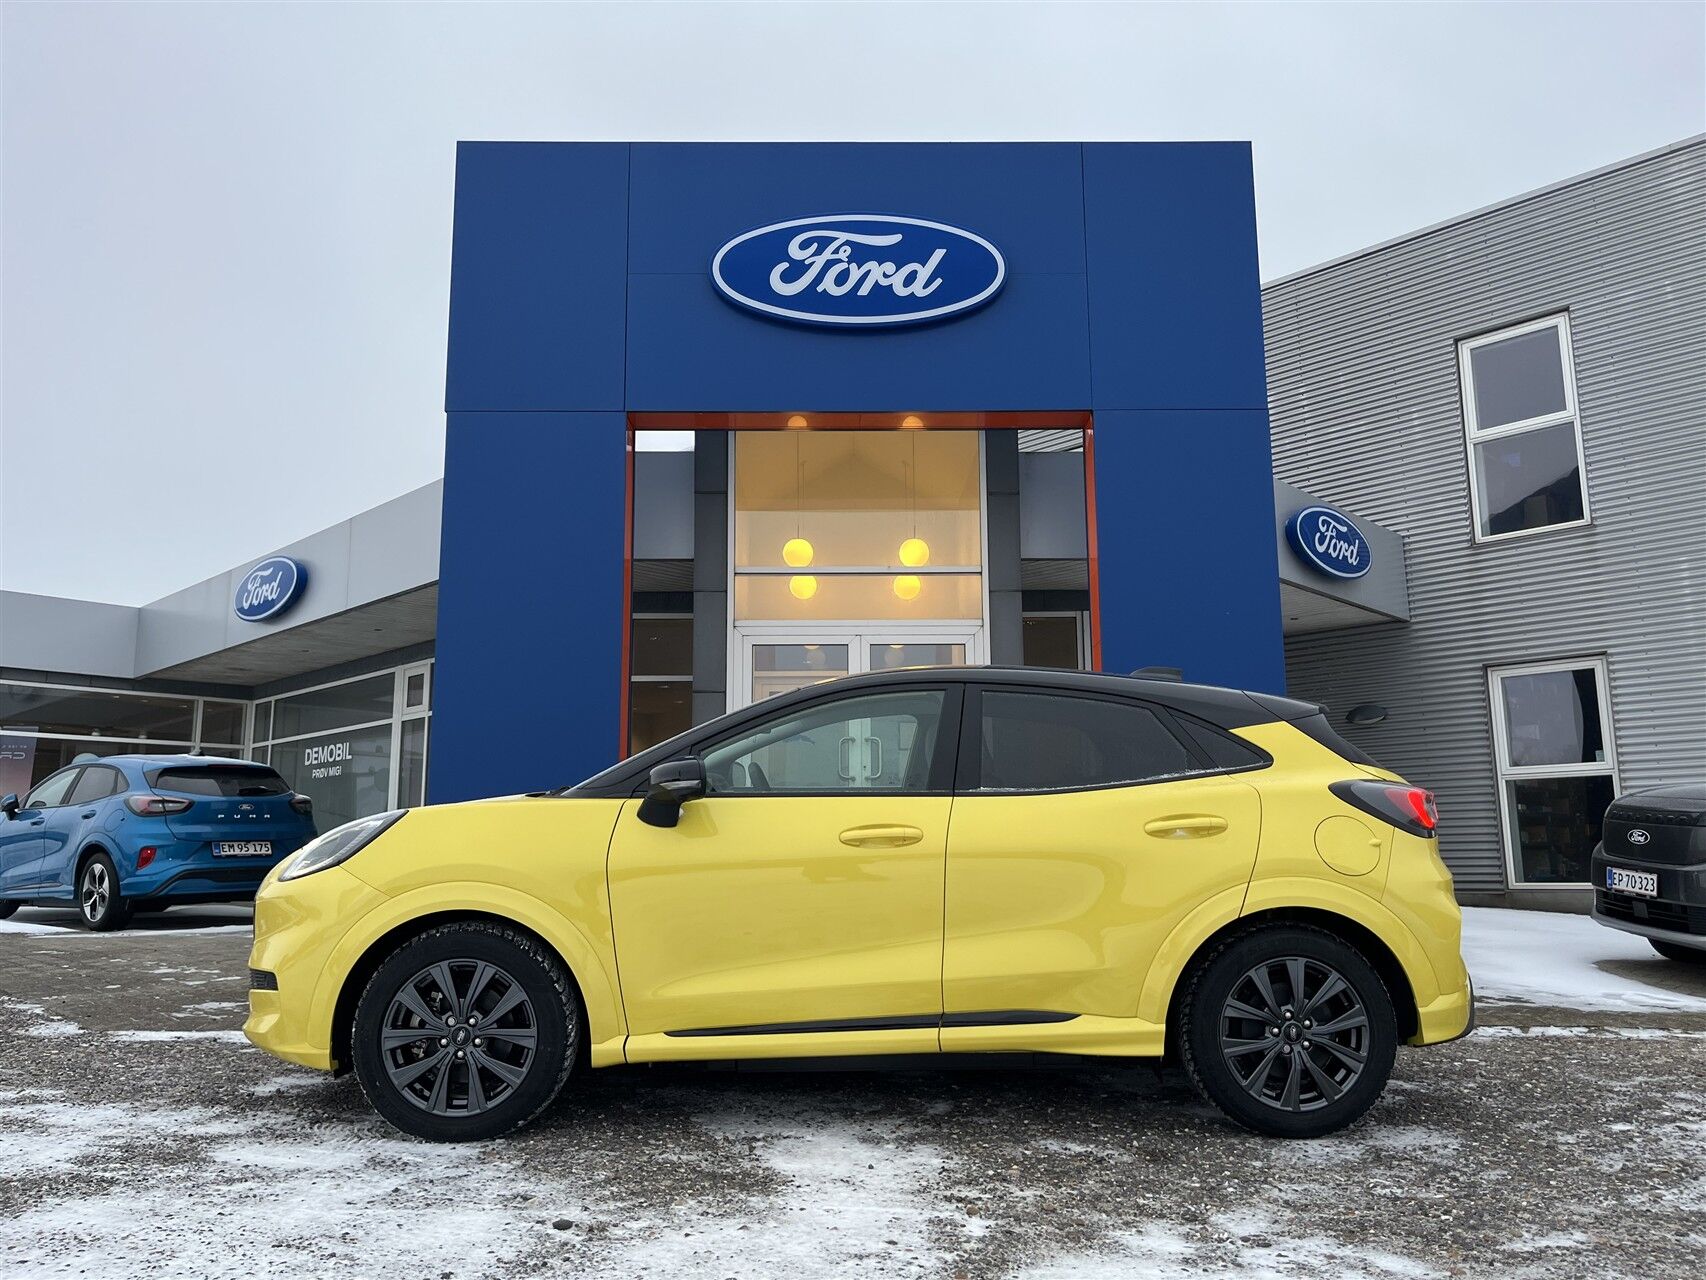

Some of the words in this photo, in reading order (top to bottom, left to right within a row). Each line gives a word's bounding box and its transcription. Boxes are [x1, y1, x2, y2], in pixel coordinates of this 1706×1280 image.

[769, 230, 947, 297] Ford
[1314, 515, 1360, 566] Ford
[242, 566, 283, 610] Ford
[304, 742, 352, 766] DEMOBIL
[221, 843, 235, 853] EM
[237, 843, 250, 853] 95
[252, 843, 270, 853] 175
[1612, 872, 1624, 886] EP
[1625, 873, 1637, 889] 70
[1638, 876, 1655, 892] 323
